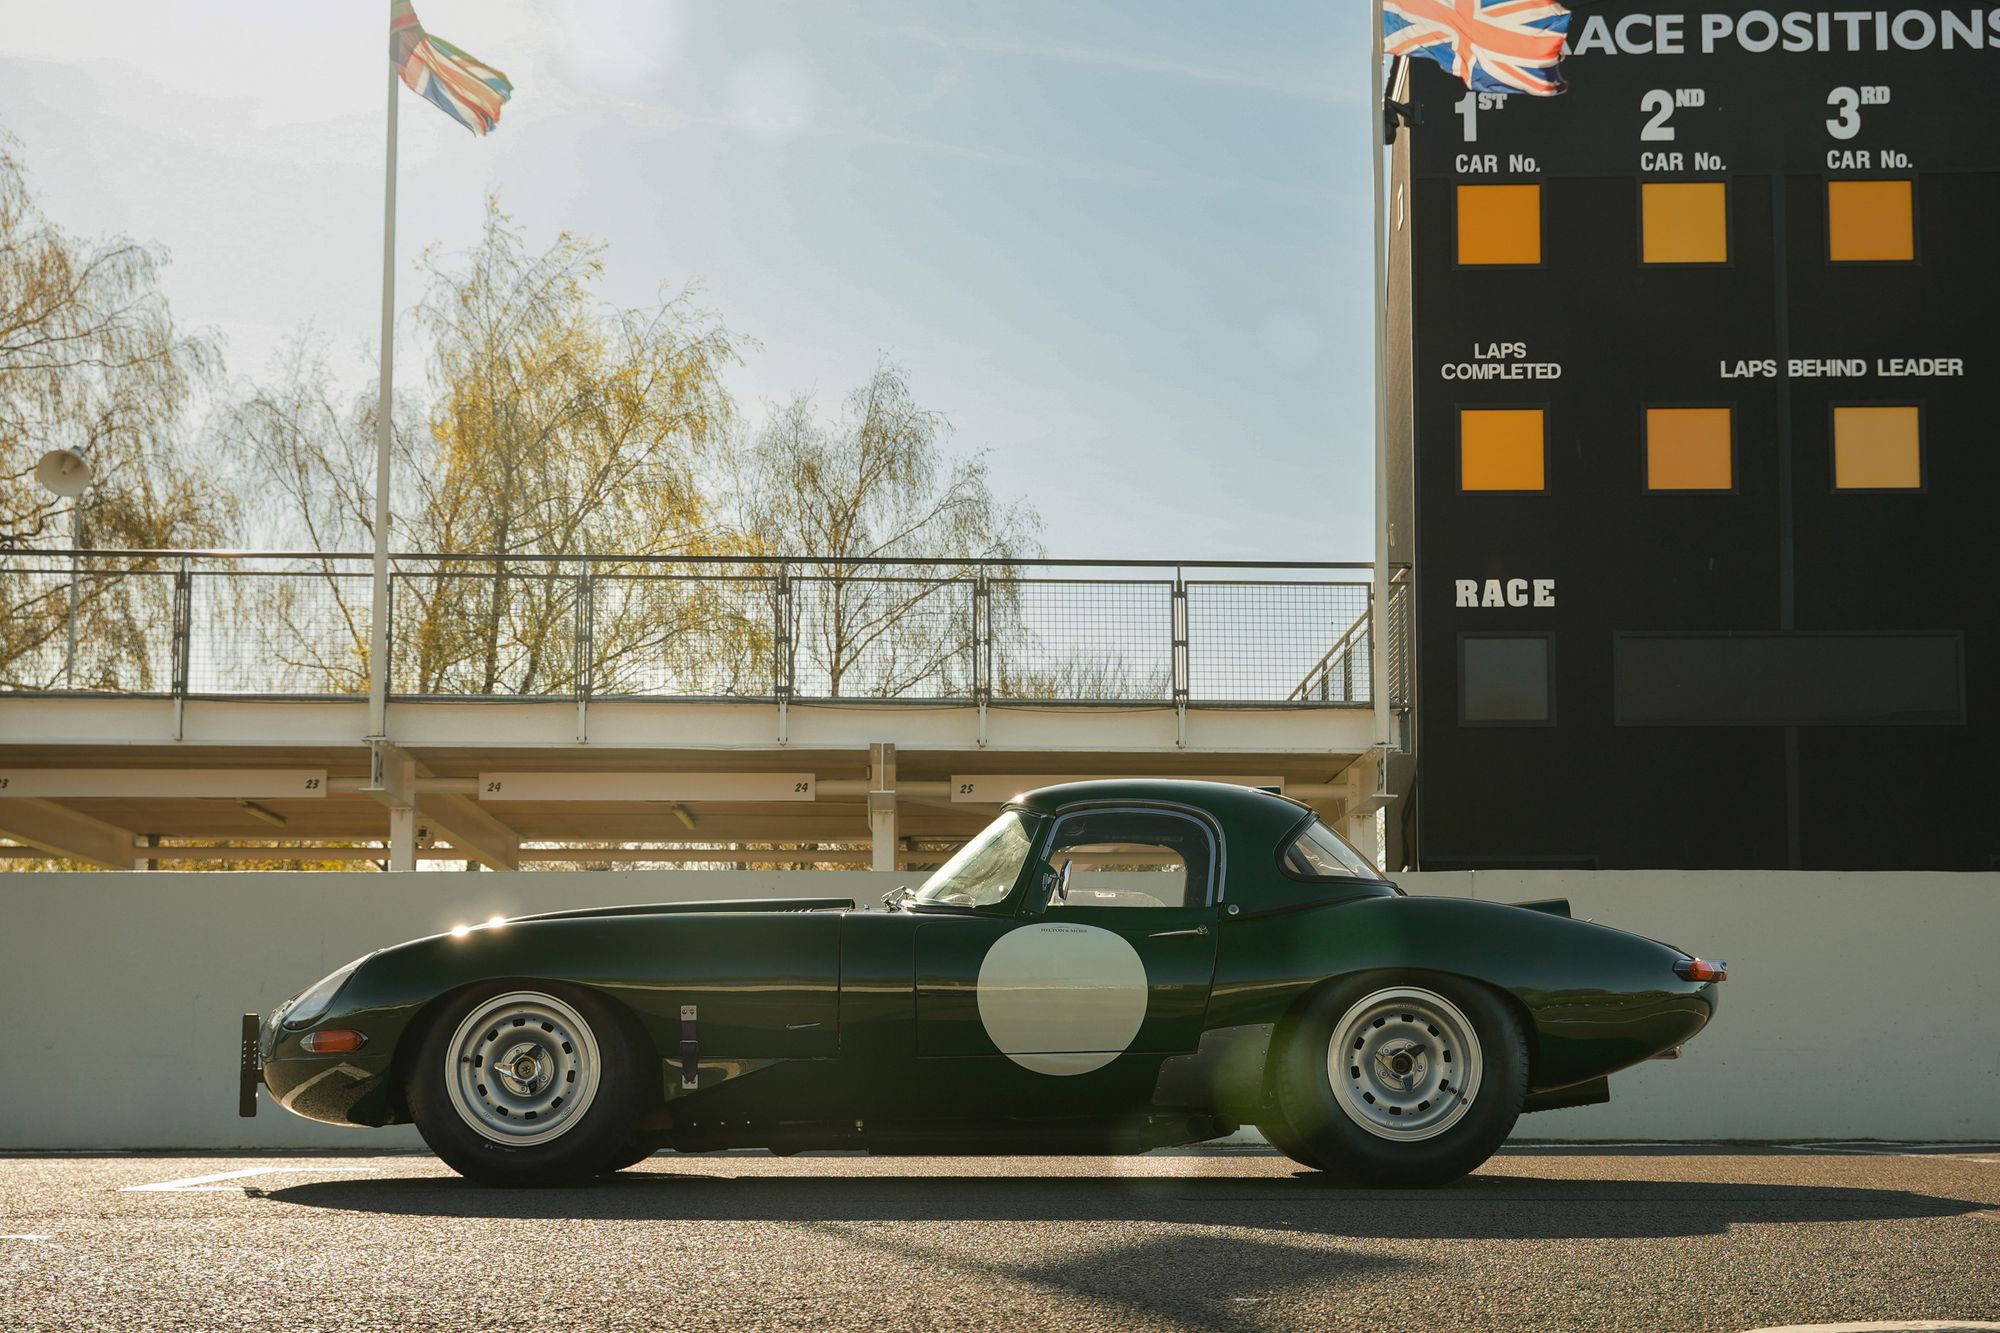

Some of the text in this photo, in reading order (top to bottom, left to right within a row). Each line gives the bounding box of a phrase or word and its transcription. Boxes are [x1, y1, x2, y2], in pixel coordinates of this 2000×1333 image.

[1560, 13, 1684, 56] ACE
[1455, 91, 1508, 142] 1ST
[1641, 89, 1705, 141] 2ND
[1826, 86, 1890, 140] 3RD
[1456, 154, 1541, 173] CAR No.
[1641, 152, 1727, 171] CAR No.
[1827, 150, 1913, 169] CAR No.
[1475, 342, 1526, 359] LAPS
[1441, 363, 1562, 380] COMPLETED
[1720, 359, 1964, 377] LAPS BEHIND LEADER
[1456, 579, 1556, 608] RACE
[0, 778, 9, 789] 3
[305, 779, 320, 789] 23
[487, 782, 502, 792] 24
[794, 783, 809, 793] 24
[960, 784, 974, 794] 25
